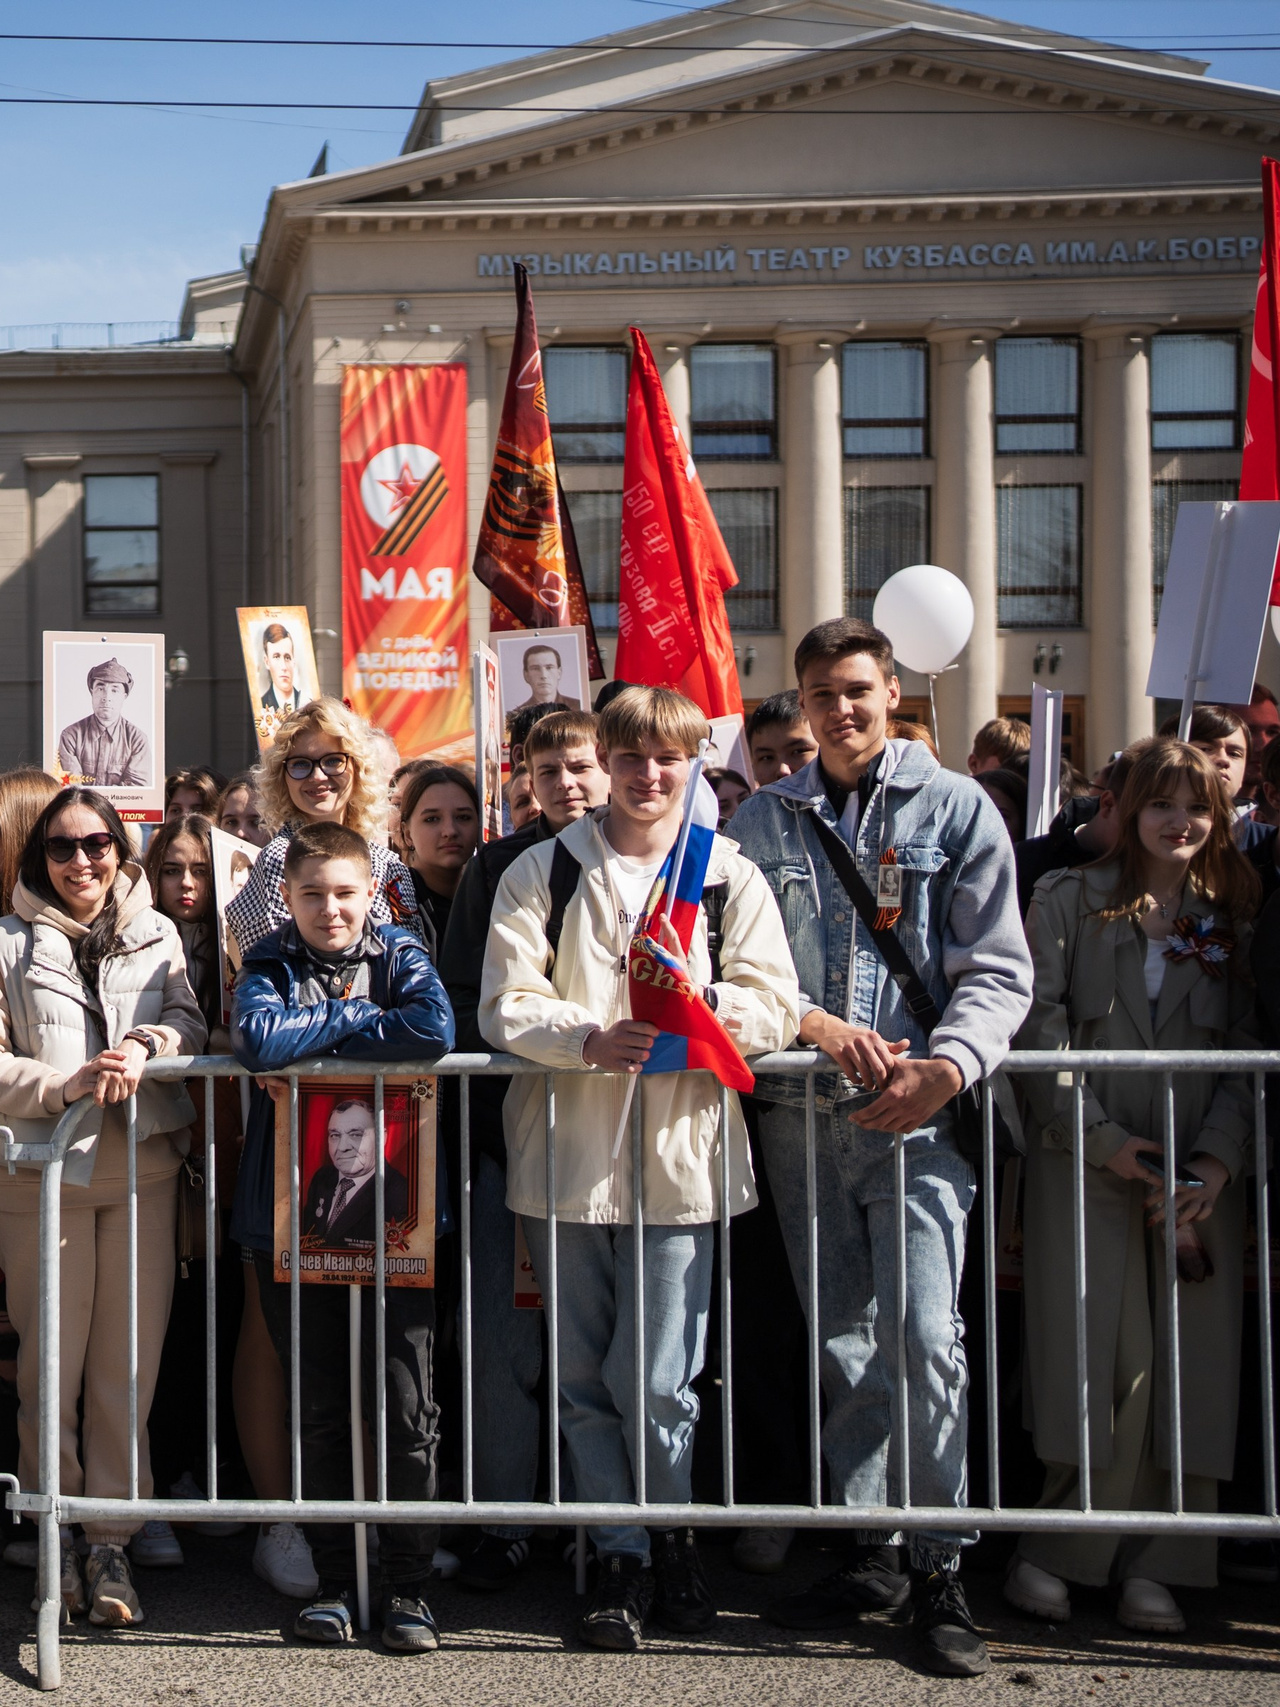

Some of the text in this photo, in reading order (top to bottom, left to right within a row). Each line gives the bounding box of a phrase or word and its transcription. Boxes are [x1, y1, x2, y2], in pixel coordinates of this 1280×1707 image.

[478, 236, 1266, 277] МУЗЫКАЛЬНЫЙ ТЕАТР КУЗБАССА ИМ.А.К.БОБР
[623, 481, 655, 518] 150
[360, 567, 453, 600] МАЯ
[381, 635, 434, 650] С ДНЁМ
[357, 647, 458, 668] ВЕЛИКОЙ
[354, 672, 458, 692] ПОБЕДЫ!
[281, 1251, 426, 1275] Счев Иван Феорович
